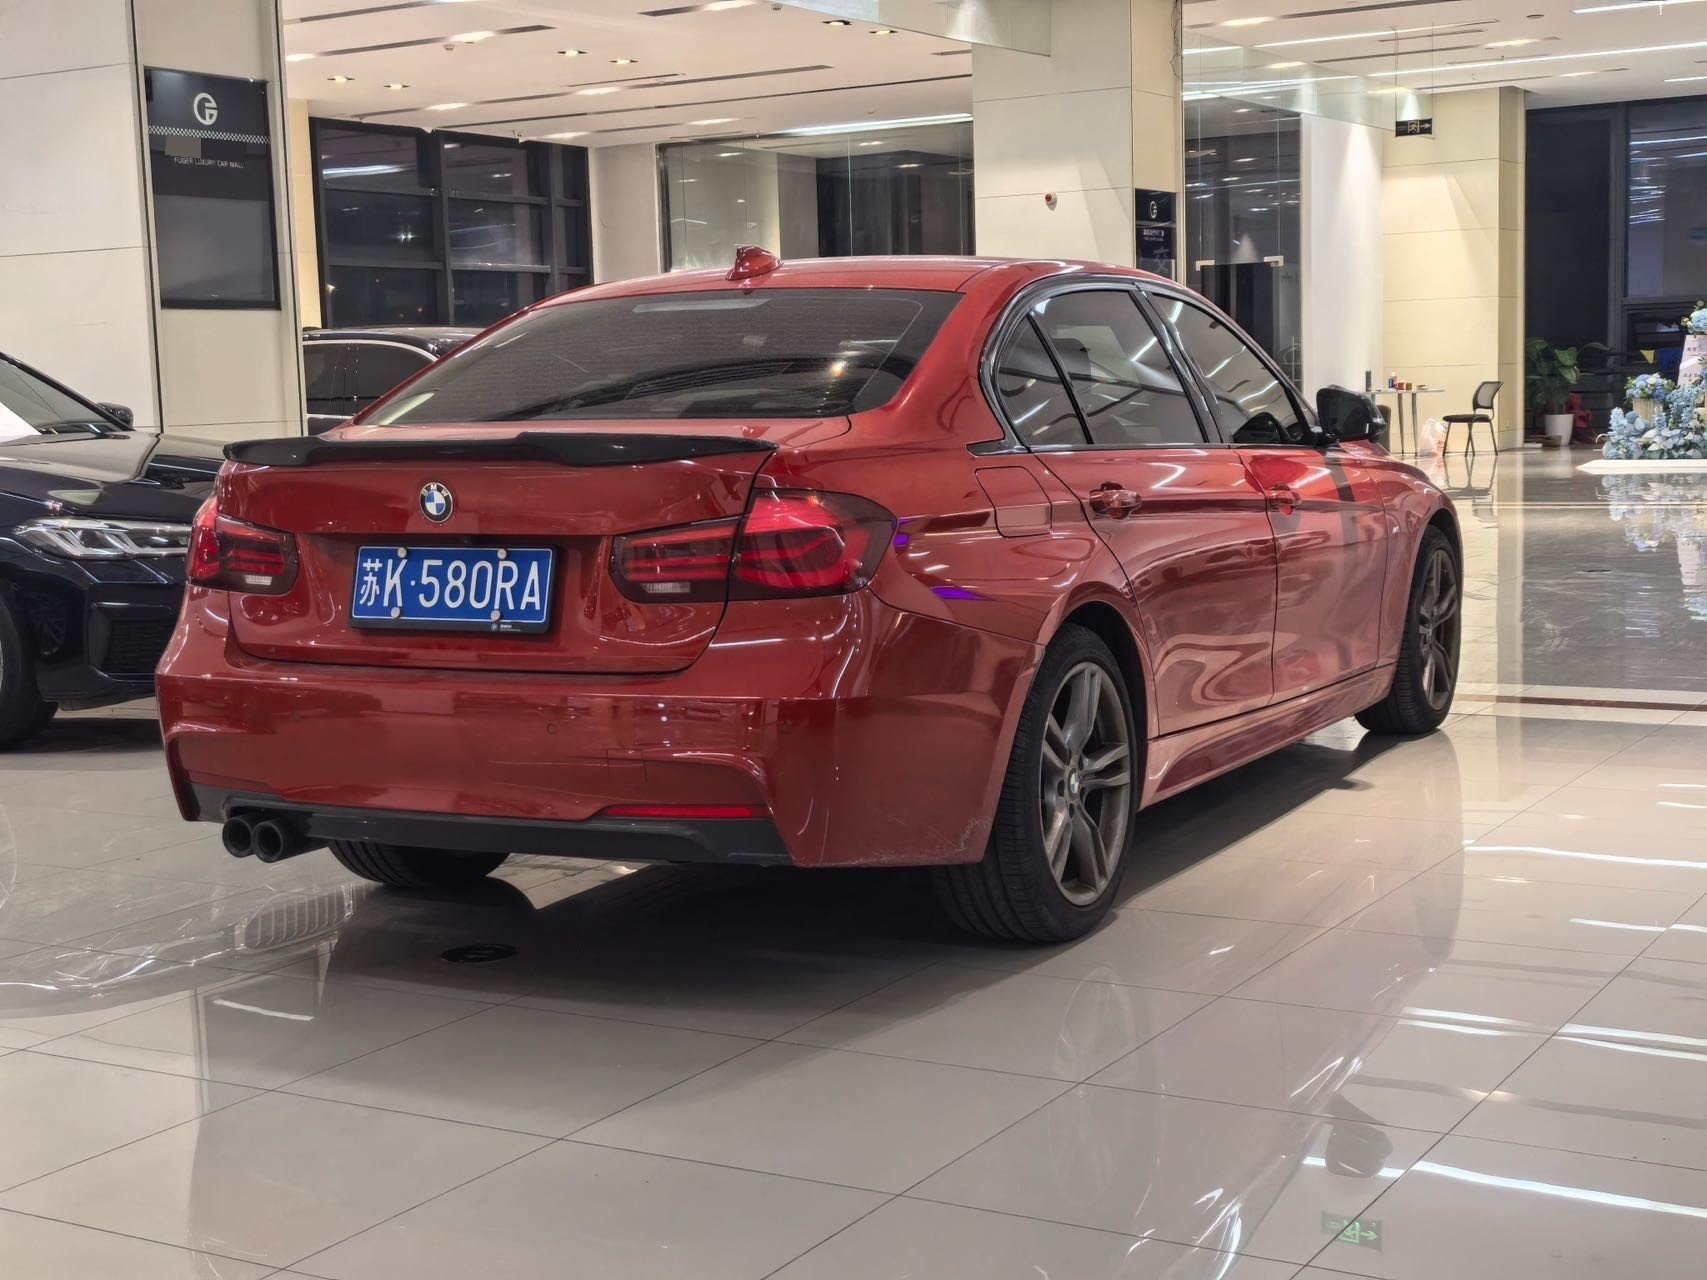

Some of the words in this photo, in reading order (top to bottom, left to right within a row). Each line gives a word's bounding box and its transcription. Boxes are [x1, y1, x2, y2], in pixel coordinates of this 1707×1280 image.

[195, 158, 215, 166] LUXURY
[229, 161, 244, 169] MALL
[420, 483, 449, 497] BMW
